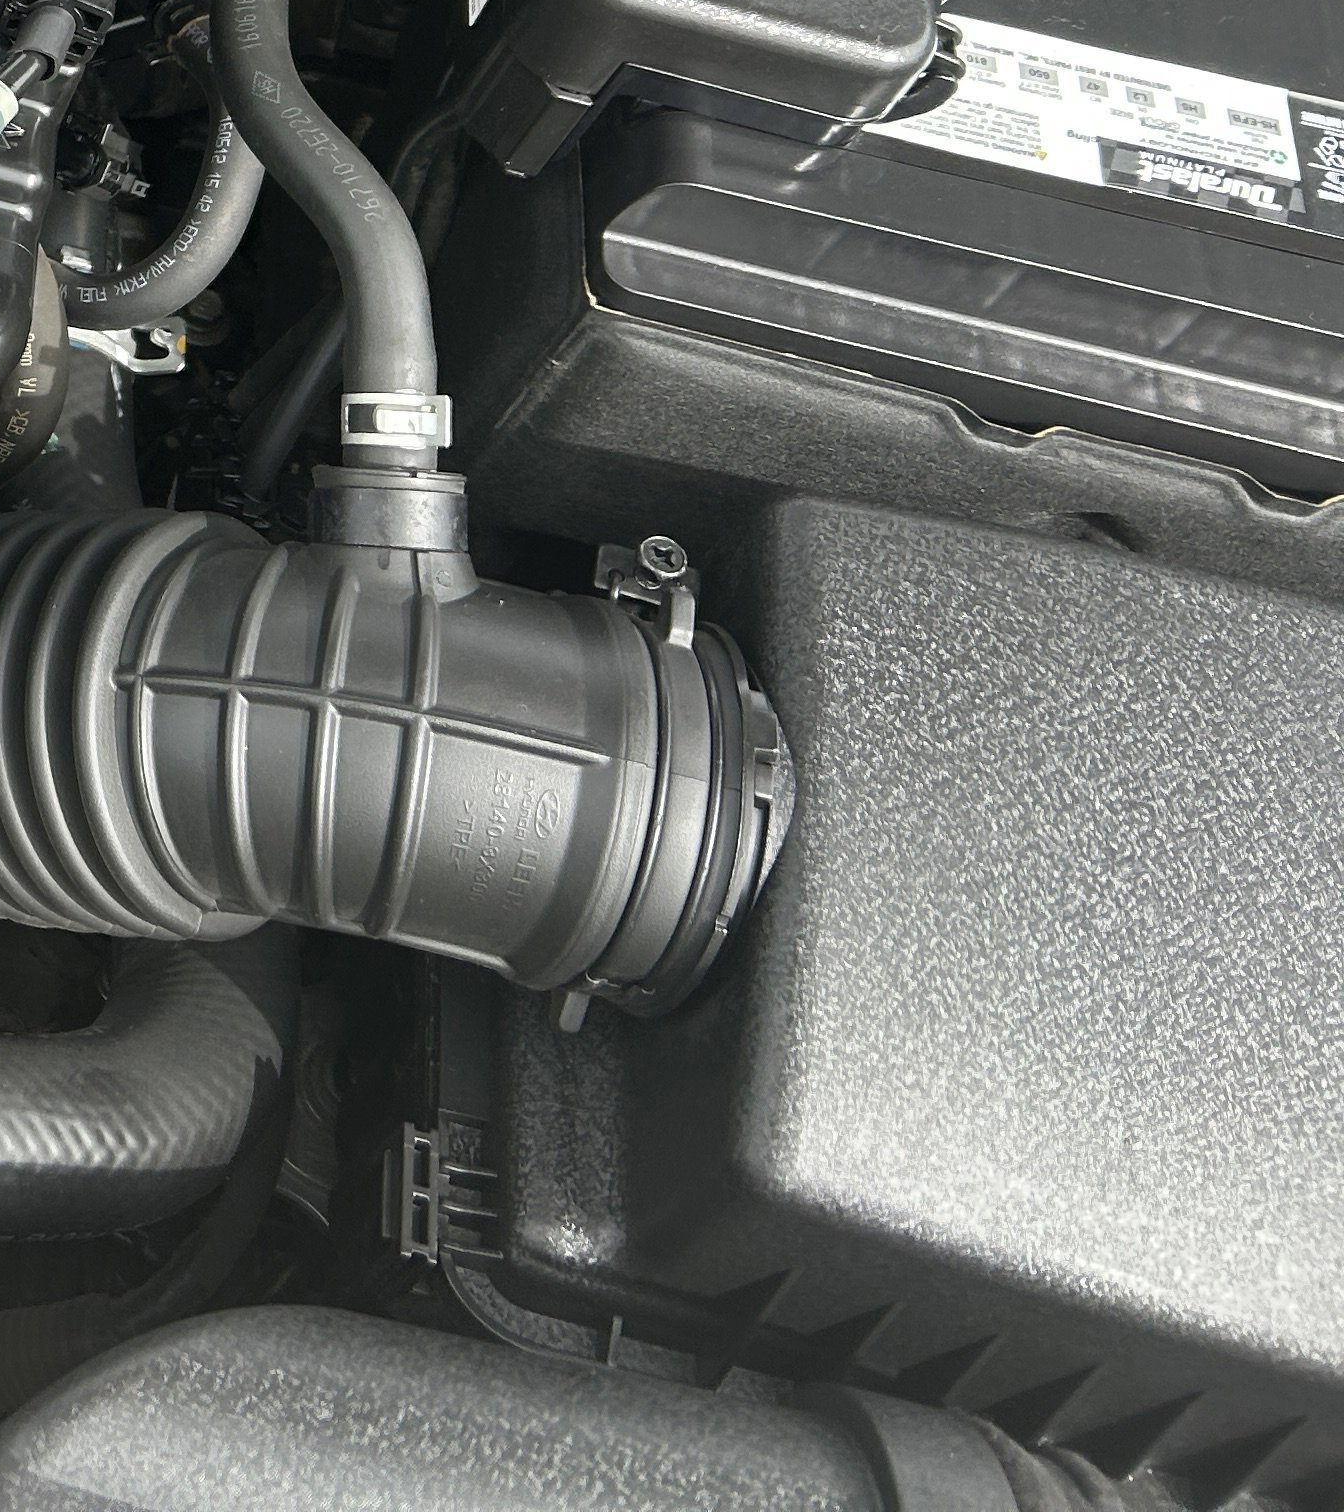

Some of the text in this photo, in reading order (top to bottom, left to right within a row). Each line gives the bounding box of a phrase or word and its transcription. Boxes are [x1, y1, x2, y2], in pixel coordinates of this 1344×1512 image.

[966, 53, 987, 65] 810
[1028, 67, 1049, 79] 650
[1086, 81, 1100, 91] 47
[210, 114, 233, 166] 160512
[279, 105, 384, 224] 26710-2E720
[1138, 149, 1225, 177] PLATINUM
[1135, 157, 1281, 211] Duralast
[77, 285, 108, 304] FUEL
